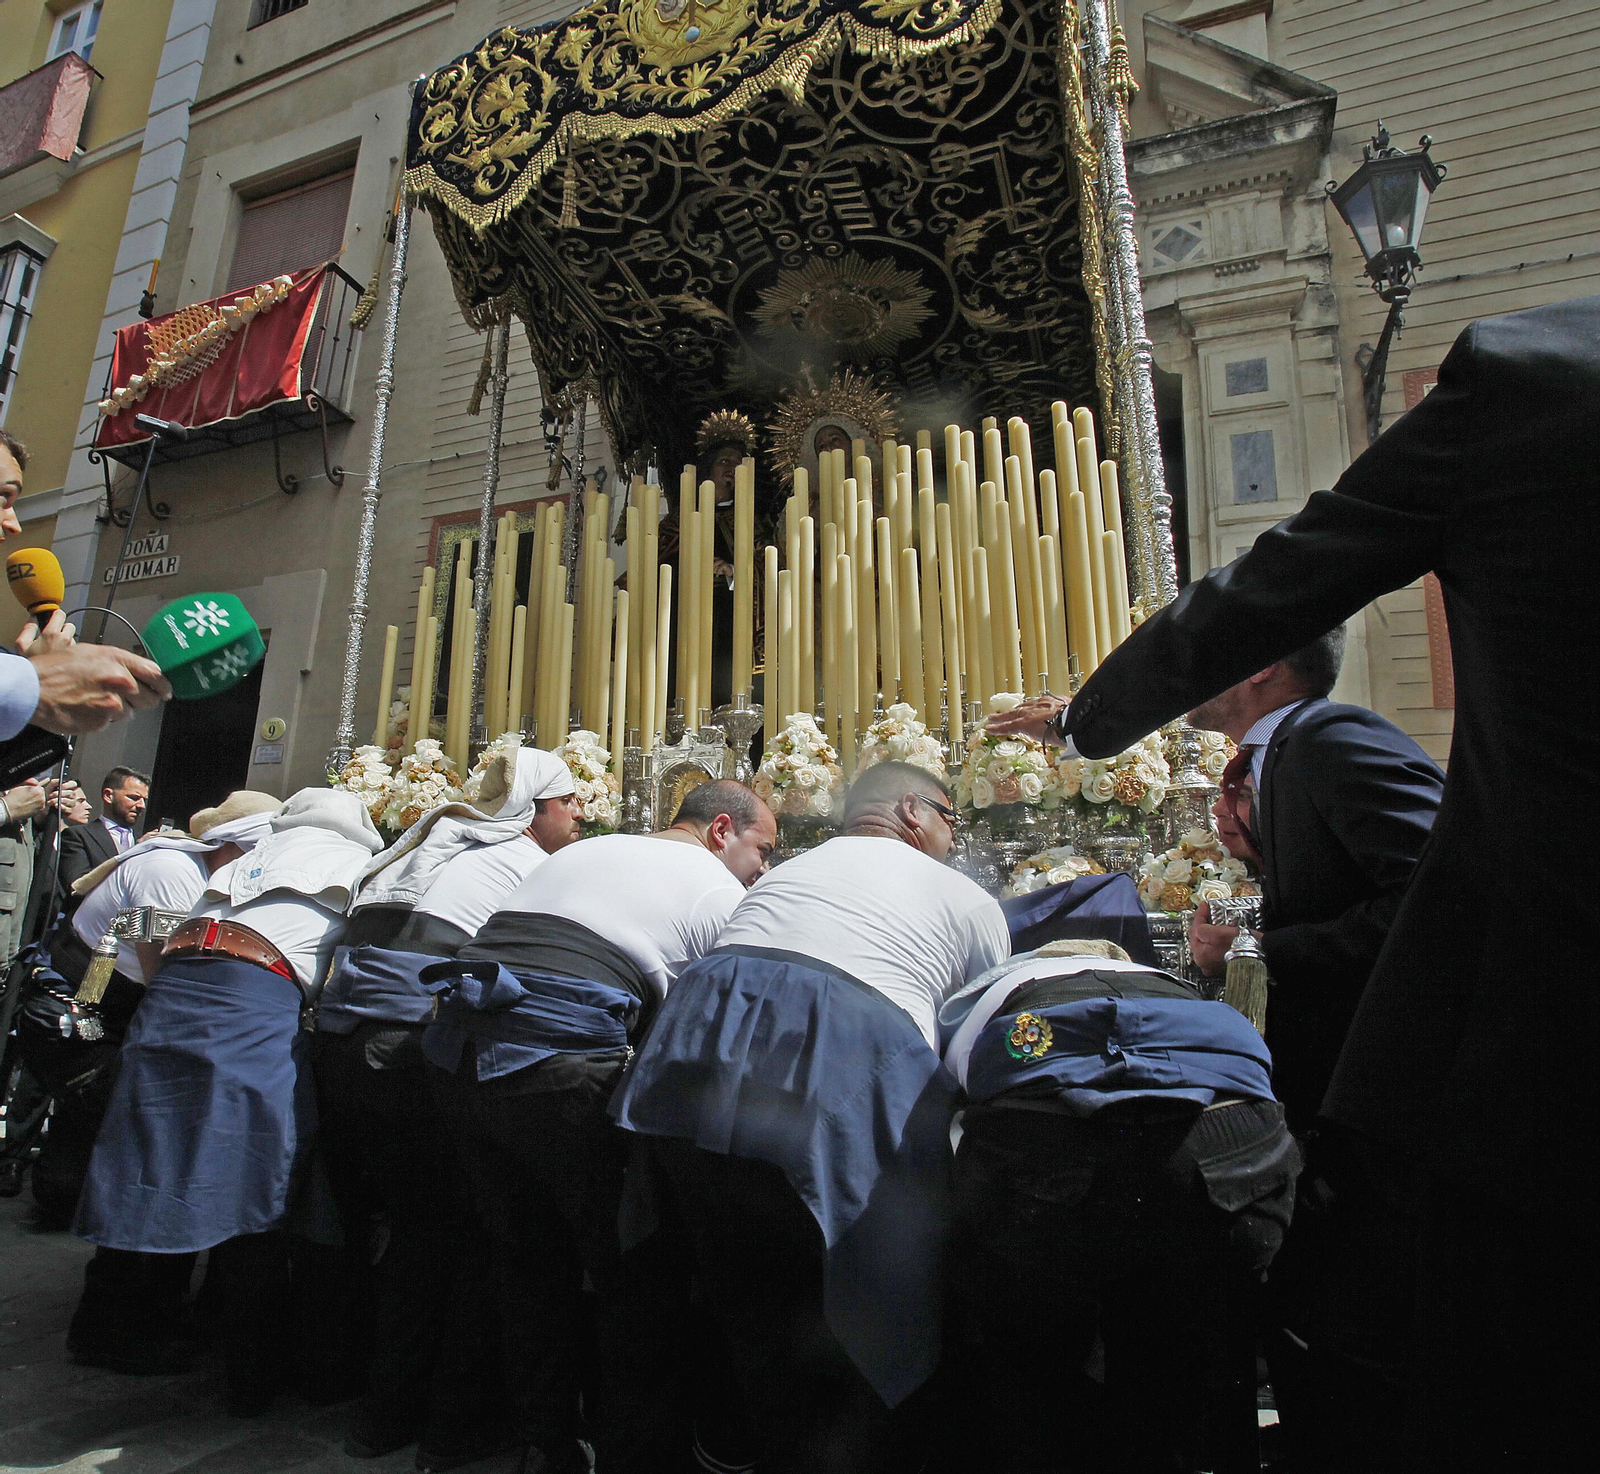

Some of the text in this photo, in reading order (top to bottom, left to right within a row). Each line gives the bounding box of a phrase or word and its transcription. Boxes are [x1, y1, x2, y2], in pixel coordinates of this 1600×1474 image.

[123, 530, 165, 557] DOÑA
[104, 556, 177, 583] GUIOMAR
[268, 724, 276, 739] 9
